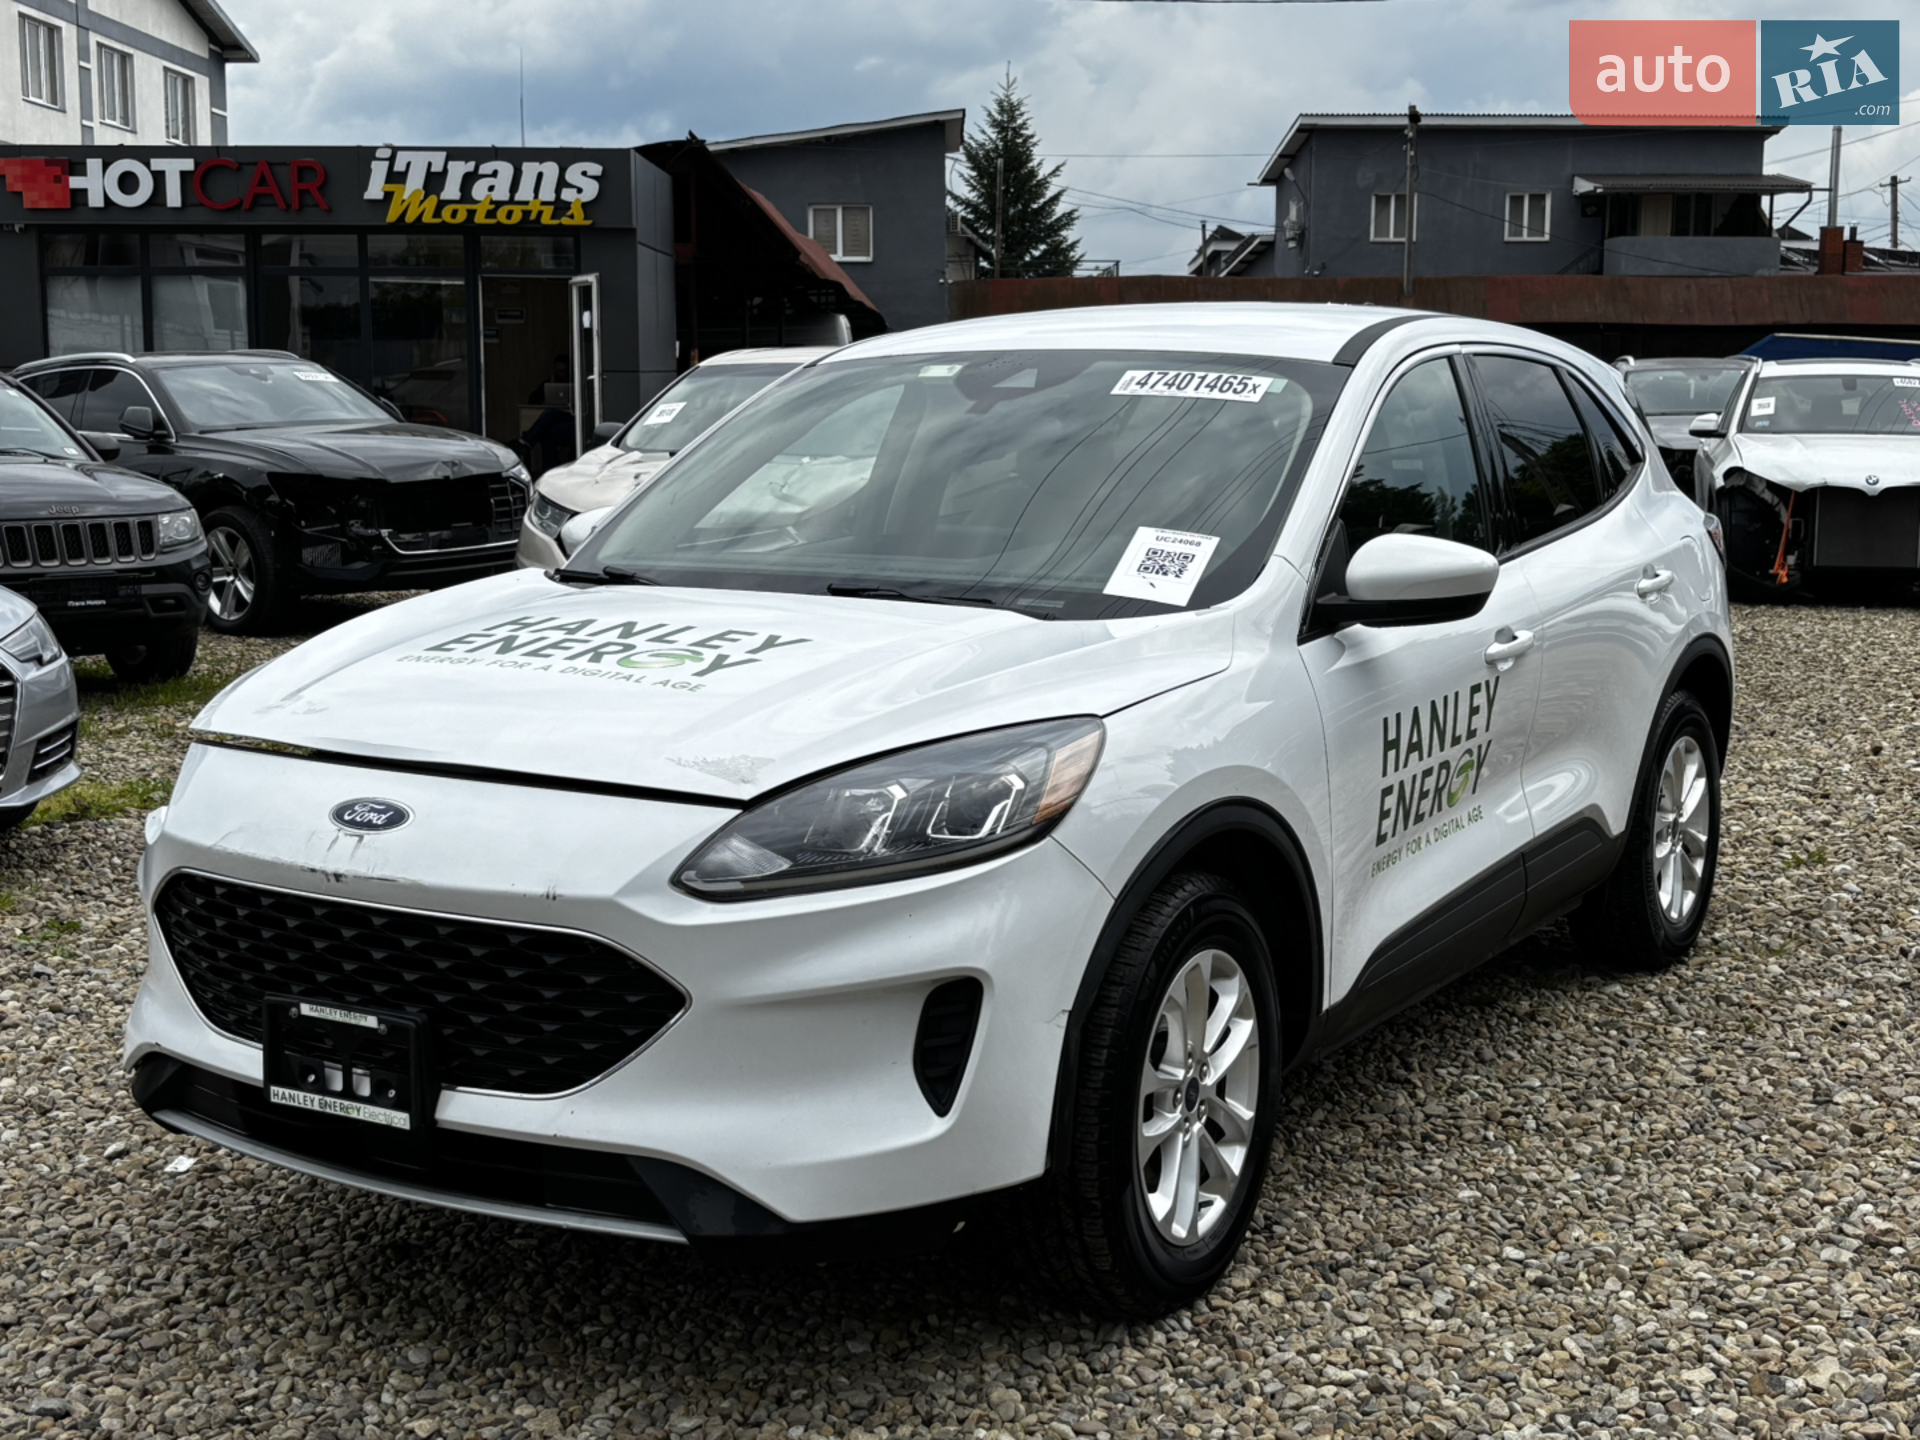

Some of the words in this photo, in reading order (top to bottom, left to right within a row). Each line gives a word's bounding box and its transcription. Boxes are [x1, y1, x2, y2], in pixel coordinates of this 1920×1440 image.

[363, 148, 603, 202] iTrans
[381, 184, 593, 225] Motors
[48, 504, 80, 515] Jeep
[423, 633, 762, 678] ENERGY
[482, 615, 813, 656] HANLEY
[396, 654, 482, 666] ENERGY
[485, 658, 533, 671] FOR
[534, 663, 552, 673] A
[559, 666, 647, 684] DIGITAL
[650, 678, 707, 693] AGE
[1382, 675, 1500, 778] HANLEY
[1375, 738, 1493, 848] ENERGY
[343, 803, 394, 825] Ford
[1371, 848, 1403, 878] ENERGY
[1406, 837, 1423, 858] FOR
[1424, 833, 1432, 847] A
[1434, 817, 1466, 843] DIGITAL
[1467, 804, 1484, 826] AGE
[309, 1004, 337, 1017] HANLEY
[272, 1089, 315, 1108] HANLEY
[318, 1097, 361, 1116] ENERGY
